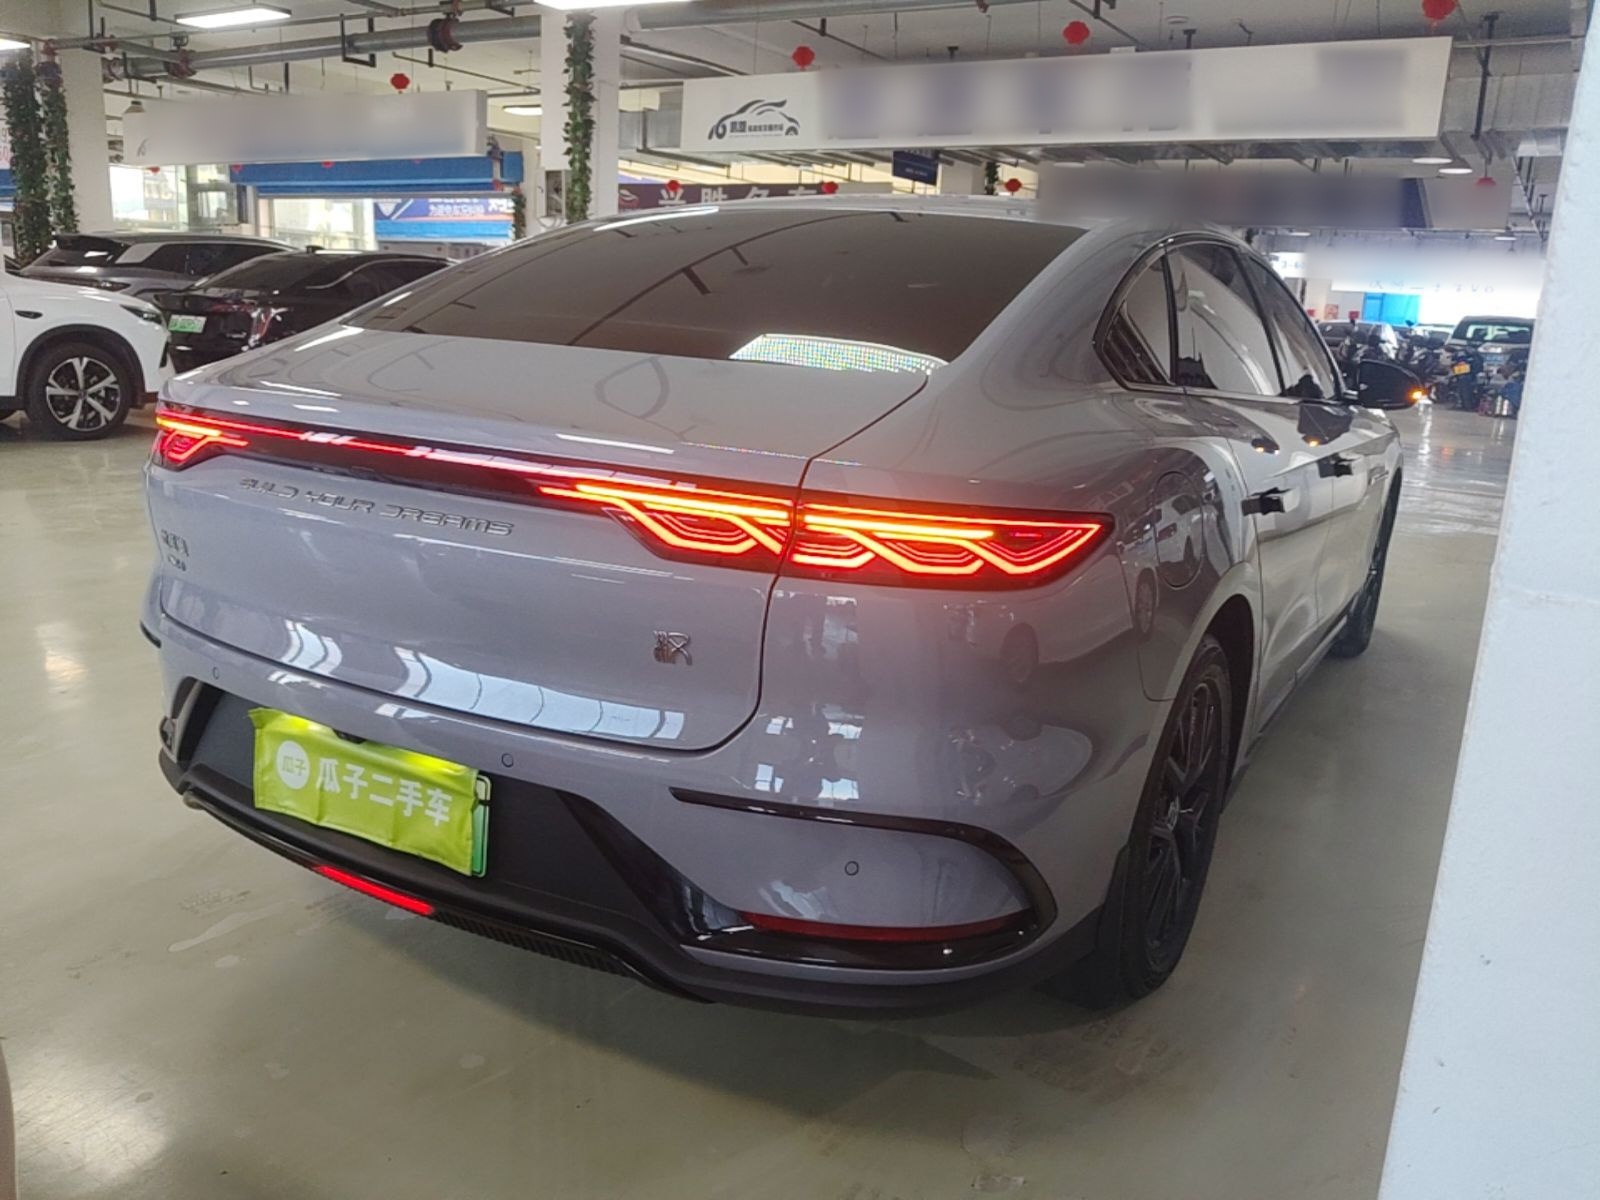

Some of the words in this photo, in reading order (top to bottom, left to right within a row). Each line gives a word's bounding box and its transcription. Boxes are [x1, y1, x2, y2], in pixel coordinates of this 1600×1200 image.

[239, 478, 299, 499] BUILD
[304, 489, 375, 514] YOUR
[379, 503, 514, 537] DREAMS
[281, 754, 307, 777] 瓜子
[315, 757, 453, 827] 瓜子二手车
